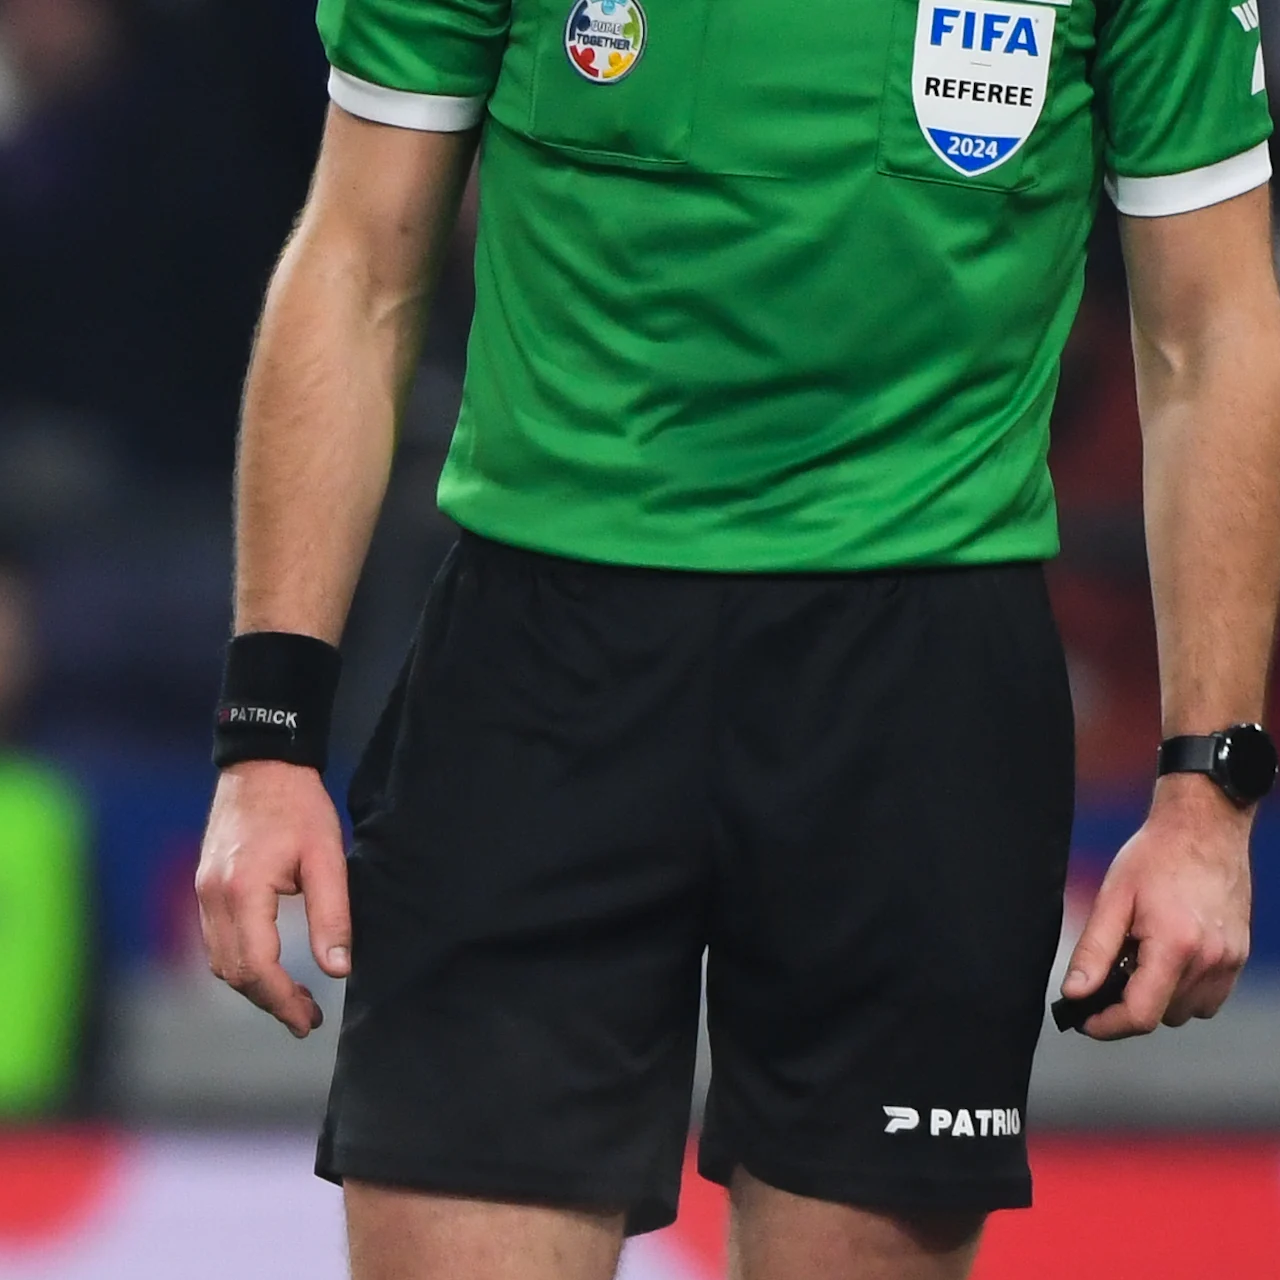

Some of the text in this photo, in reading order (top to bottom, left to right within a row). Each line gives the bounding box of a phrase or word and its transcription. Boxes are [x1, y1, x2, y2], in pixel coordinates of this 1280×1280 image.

[576, 32, 631, 51] TOGETHER
[930, 7, 1039, 57] FIFA
[924, 76, 1034, 107] REFEREE
[947, 136, 998, 159] 2024
[229, 706, 298, 728] PATRICK
